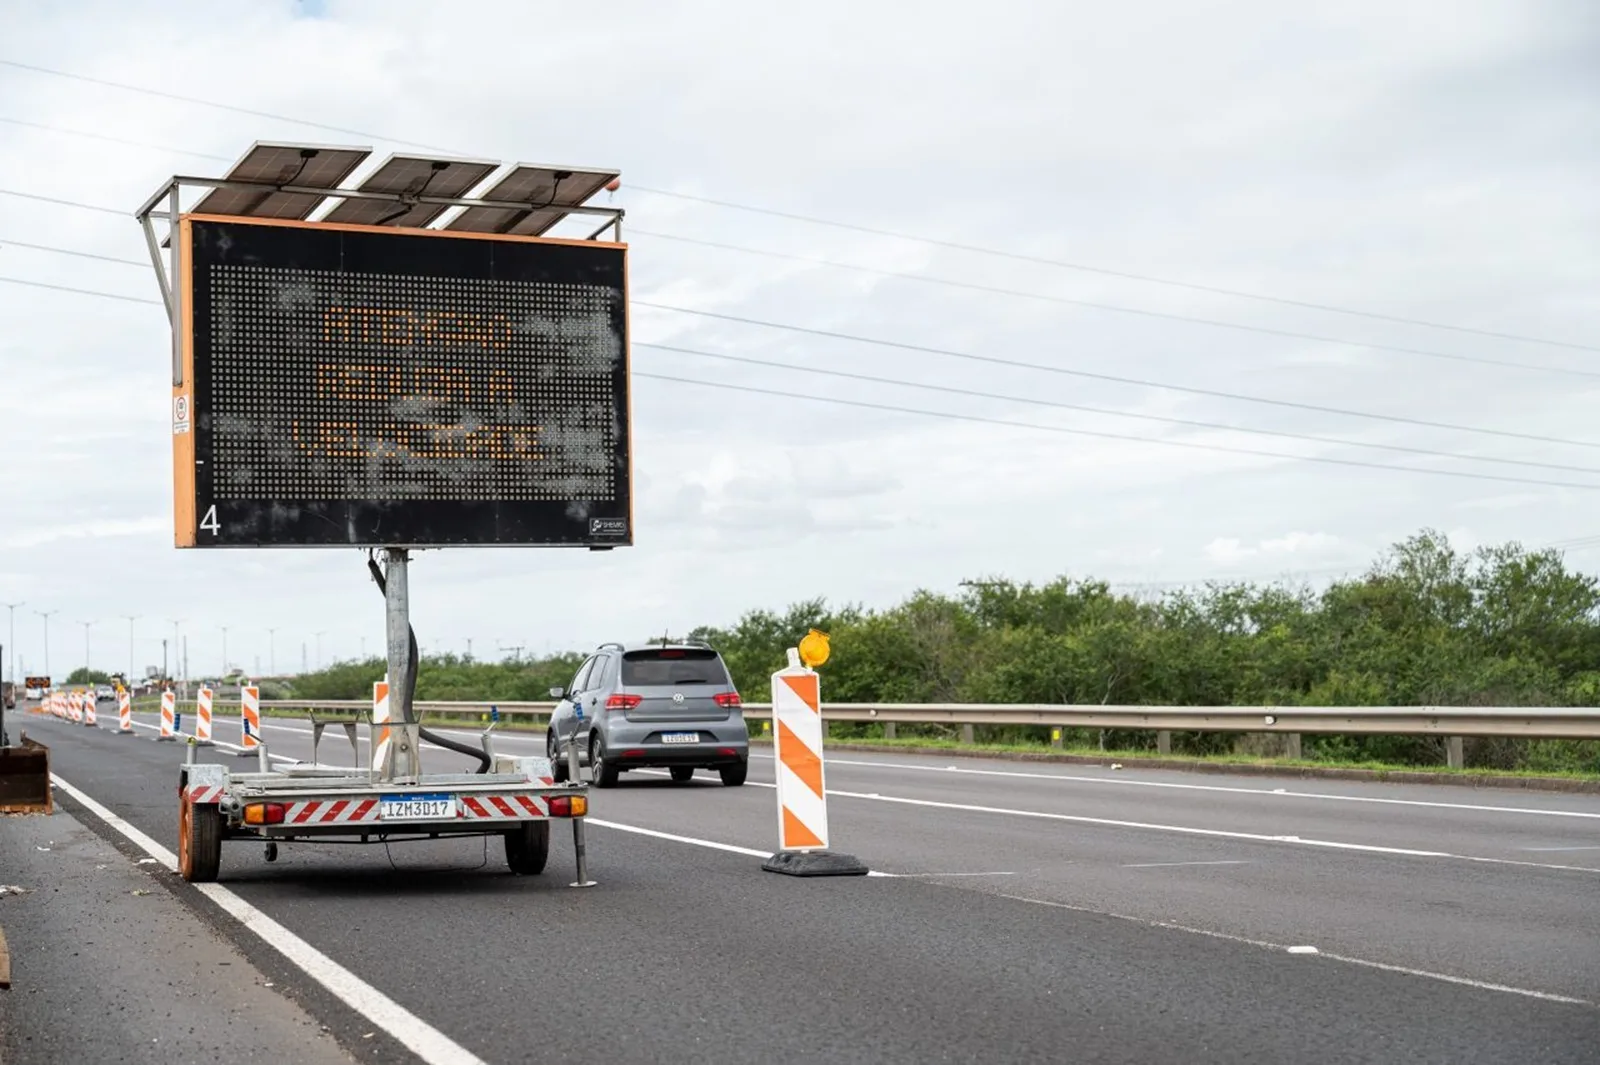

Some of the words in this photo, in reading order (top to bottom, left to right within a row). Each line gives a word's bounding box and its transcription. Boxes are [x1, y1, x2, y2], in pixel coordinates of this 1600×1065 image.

[489, 369, 514, 404] A
[200, 504, 221, 536] 4
[387, 801, 448, 817] IZM3D17
